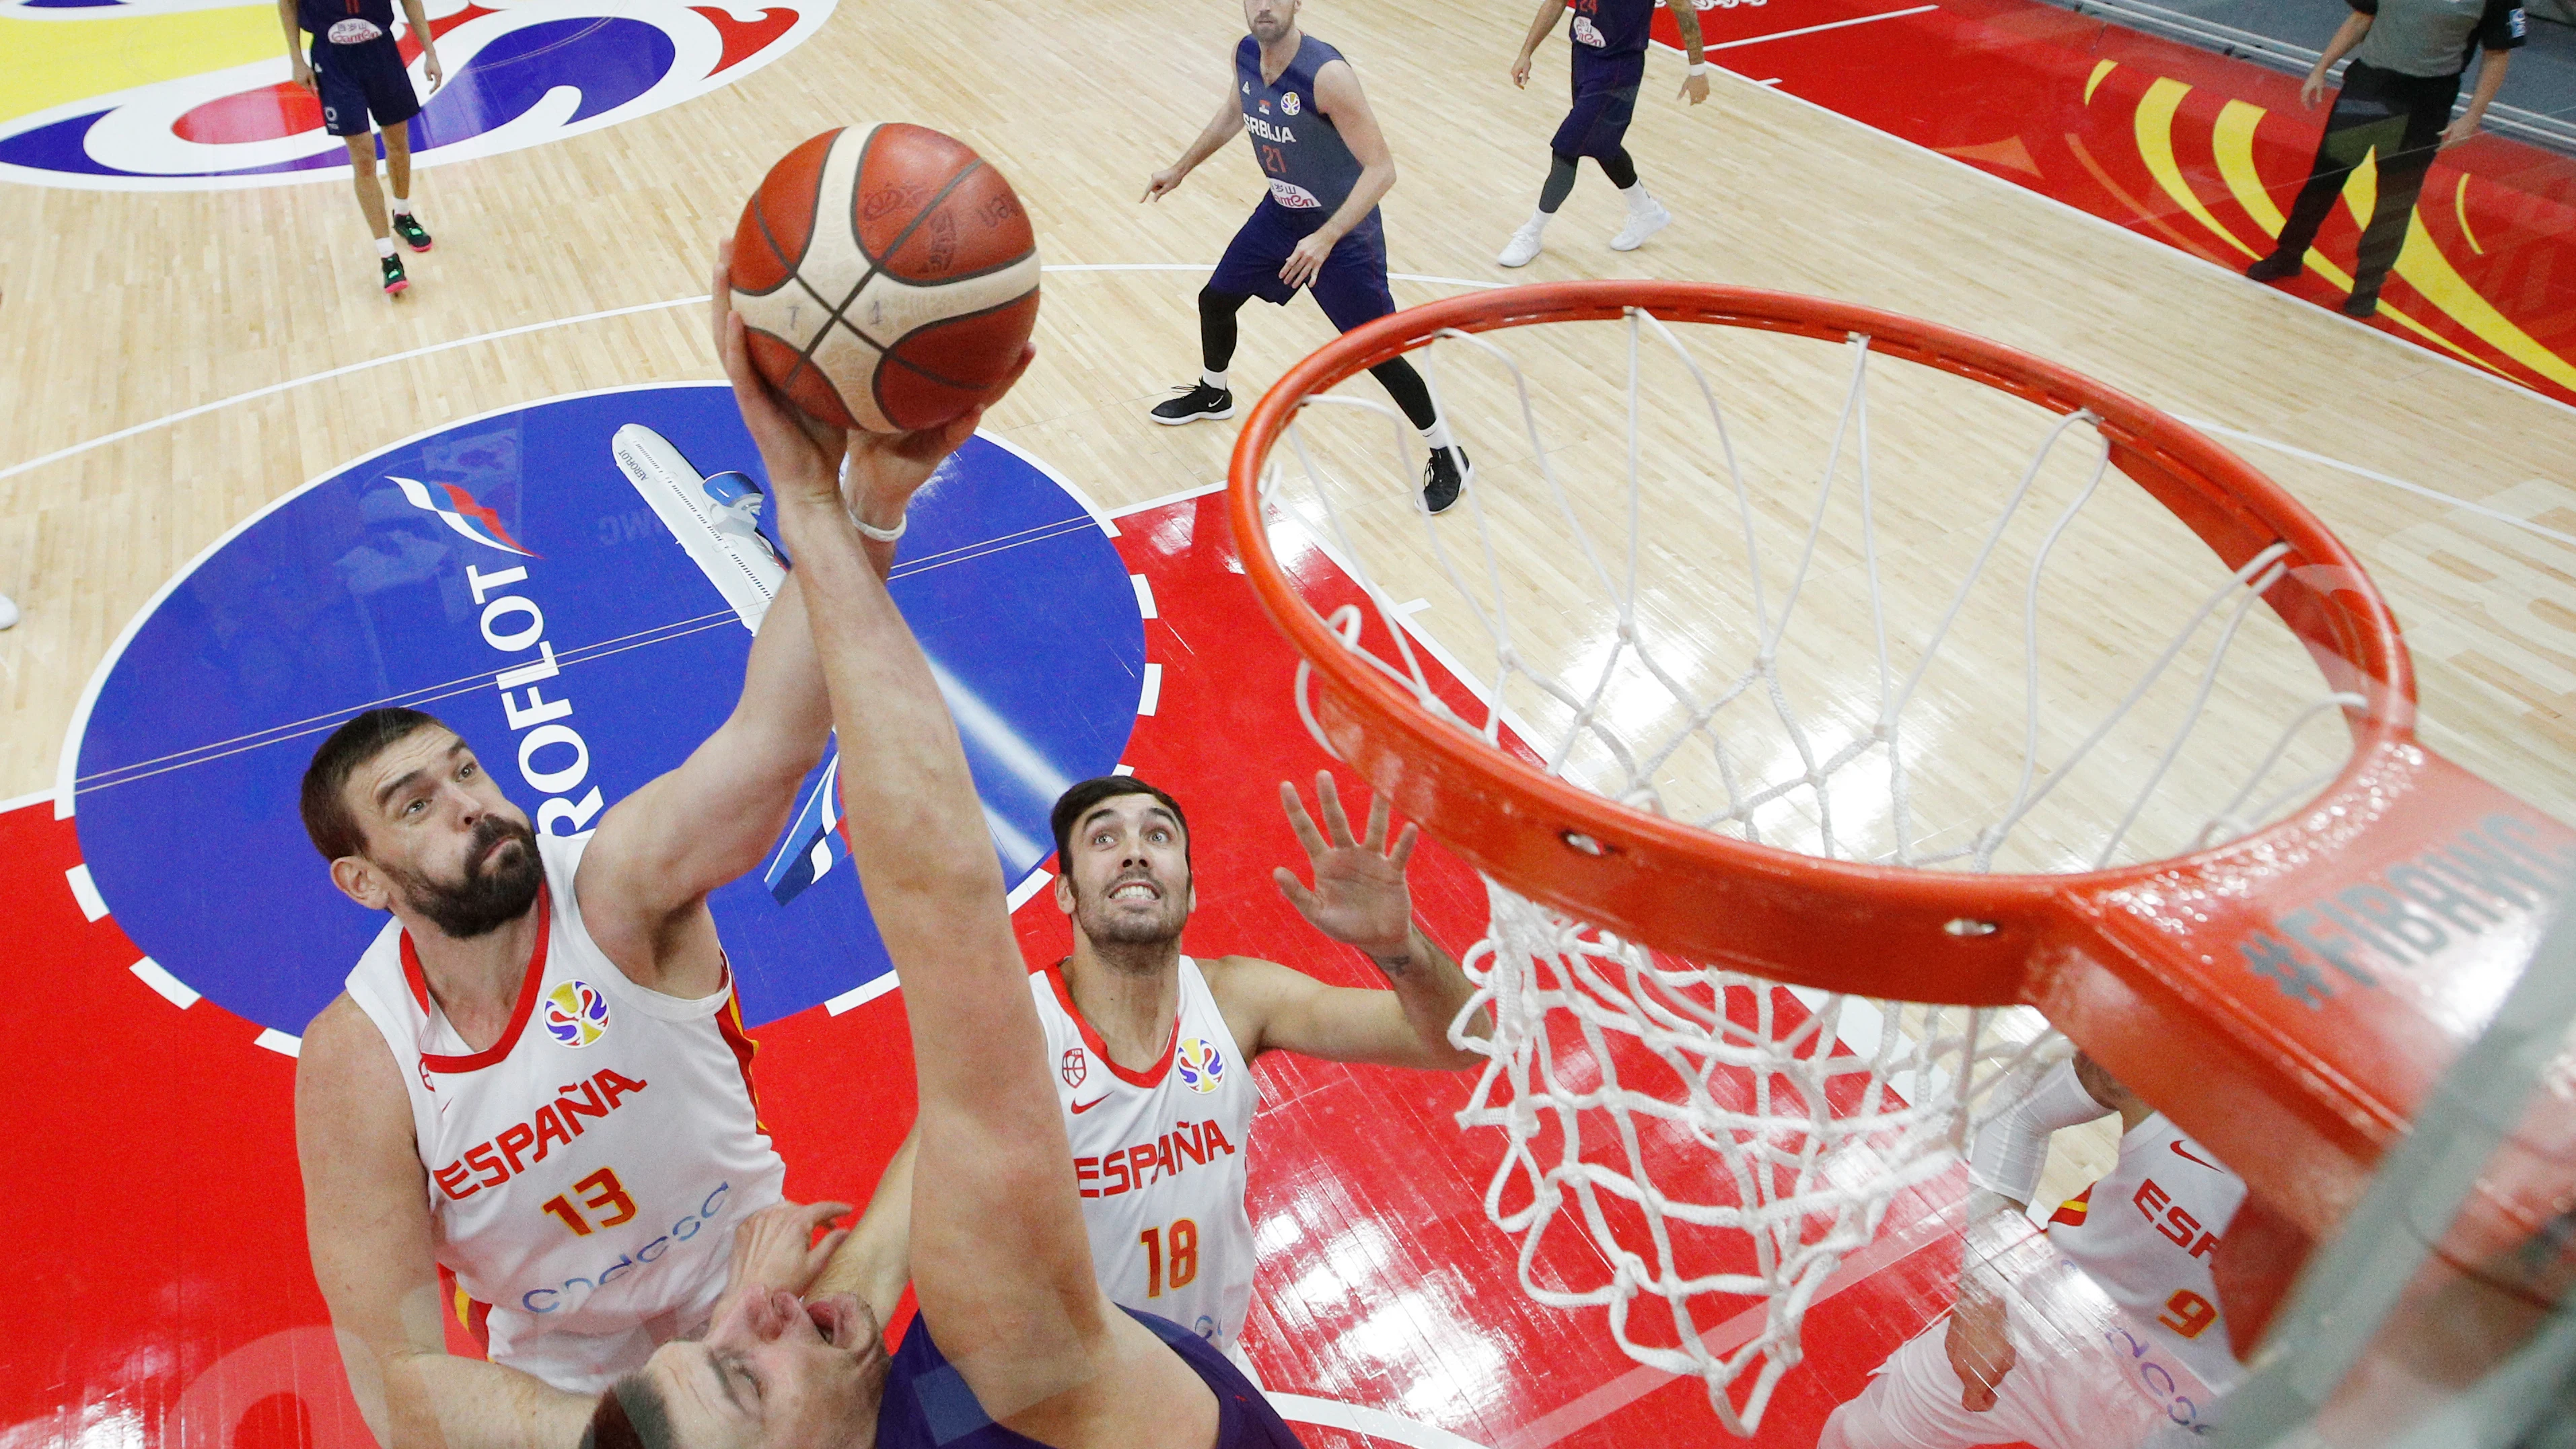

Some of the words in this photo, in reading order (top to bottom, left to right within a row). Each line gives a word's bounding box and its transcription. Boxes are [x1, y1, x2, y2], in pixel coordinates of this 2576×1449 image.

[1242, 112, 1297, 143] SRBIJA
[1262, 144, 1287, 173] 21
[617, 450, 649, 481] AEROFLOT
[465, 564, 604, 837] ROFLOT
[433, 1068, 648, 1200] ESPAÑA
[1073, 1119, 1236, 1199] ESPAÑA
[540, 1166, 638, 1236] 13
[2132, 1178, 2221, 1259] ESP
[1140, 1217, 1199, 1299] 18
[2157, 1288, 2219, 1340] 9
